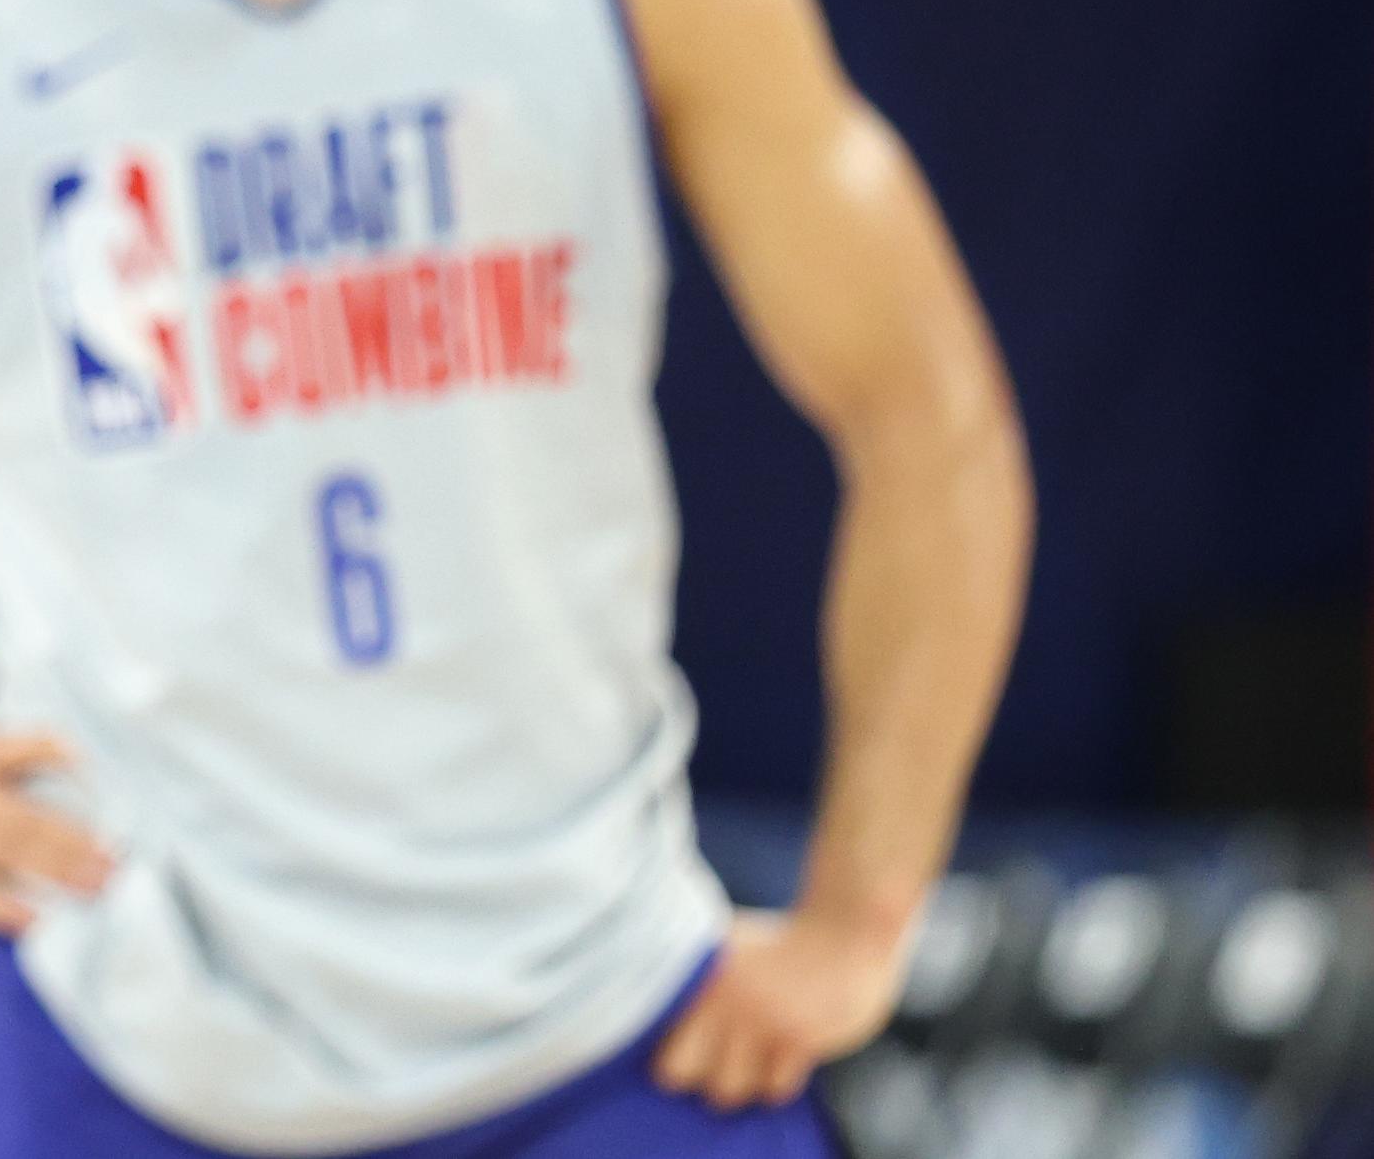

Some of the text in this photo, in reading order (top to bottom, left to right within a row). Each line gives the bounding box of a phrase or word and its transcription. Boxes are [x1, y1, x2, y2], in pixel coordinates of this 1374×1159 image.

[199, 101, 453, 272] DRAFT
[218, 244, 573, 422] COMBINE
[319, 474, 394, 666] 6
